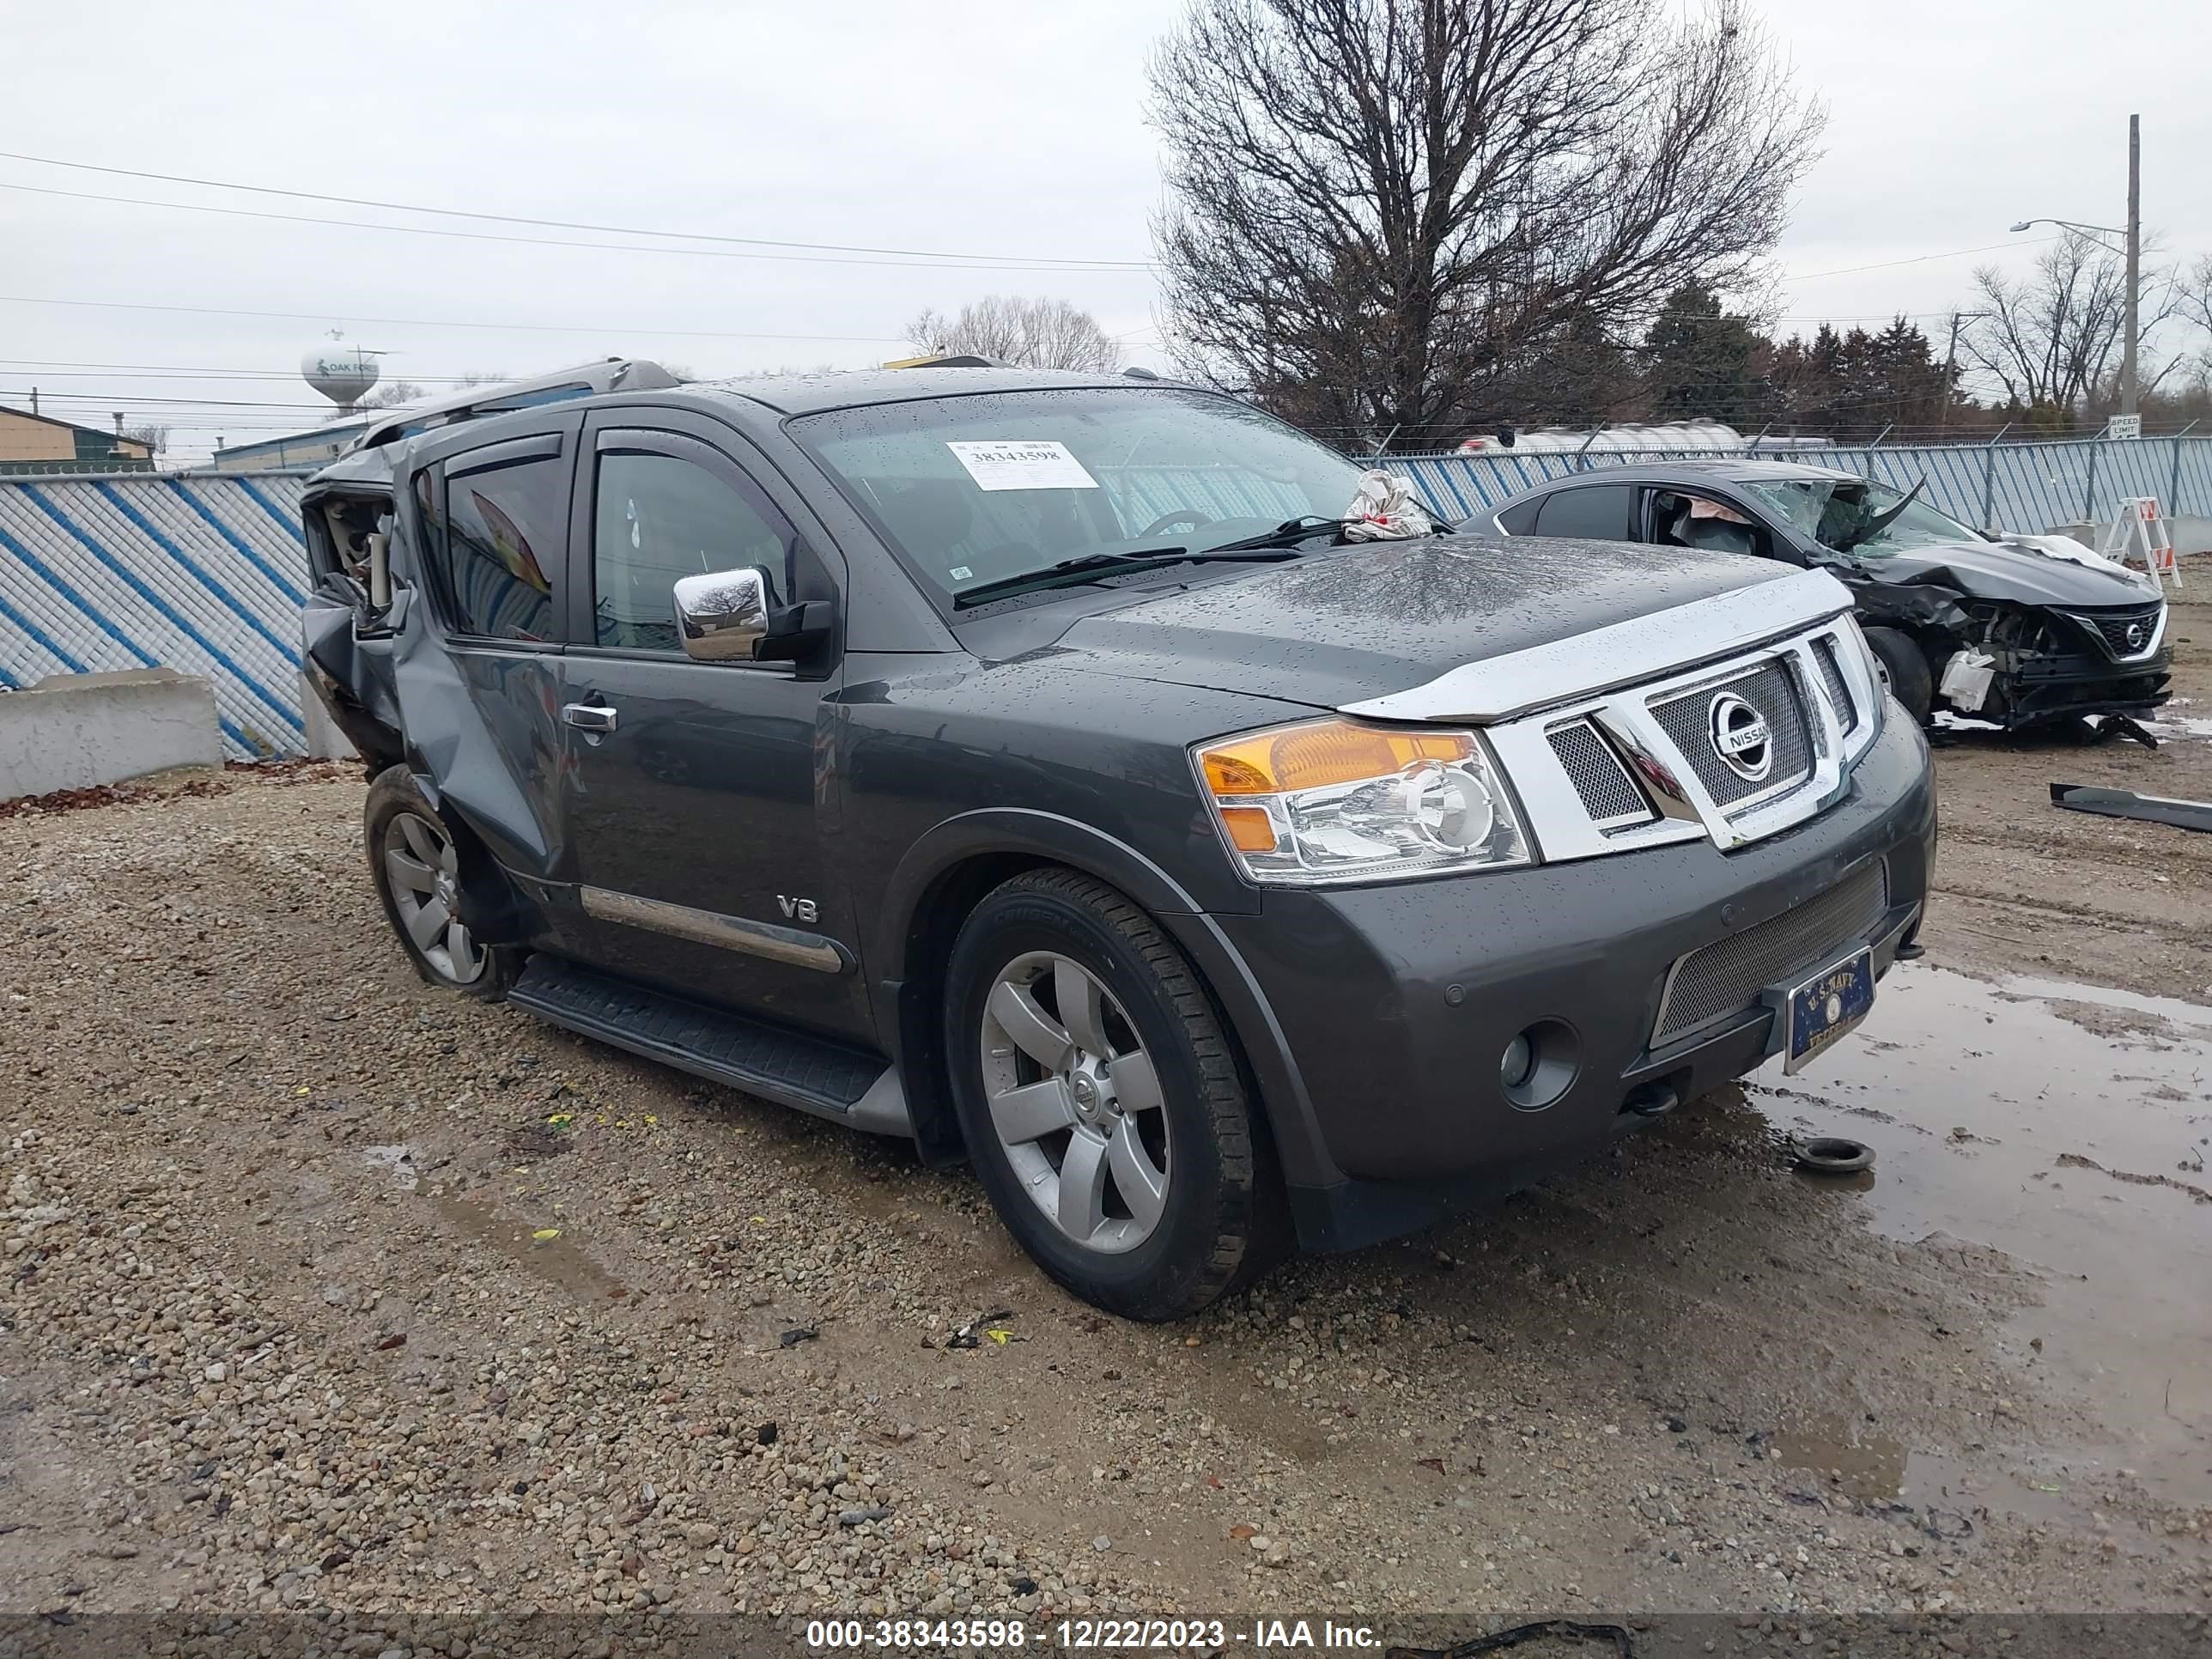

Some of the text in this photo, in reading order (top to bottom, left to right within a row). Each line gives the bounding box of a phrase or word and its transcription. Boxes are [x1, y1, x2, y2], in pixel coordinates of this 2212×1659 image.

[2112, 417, 2137, 426] SPEED
[969, 451, 1061, 463] 38343598
[1729, 725, 1769, 749] NISSAN
[776, 894, 817, 923] V8
[1828, 972, 1855, 990] NAVY
